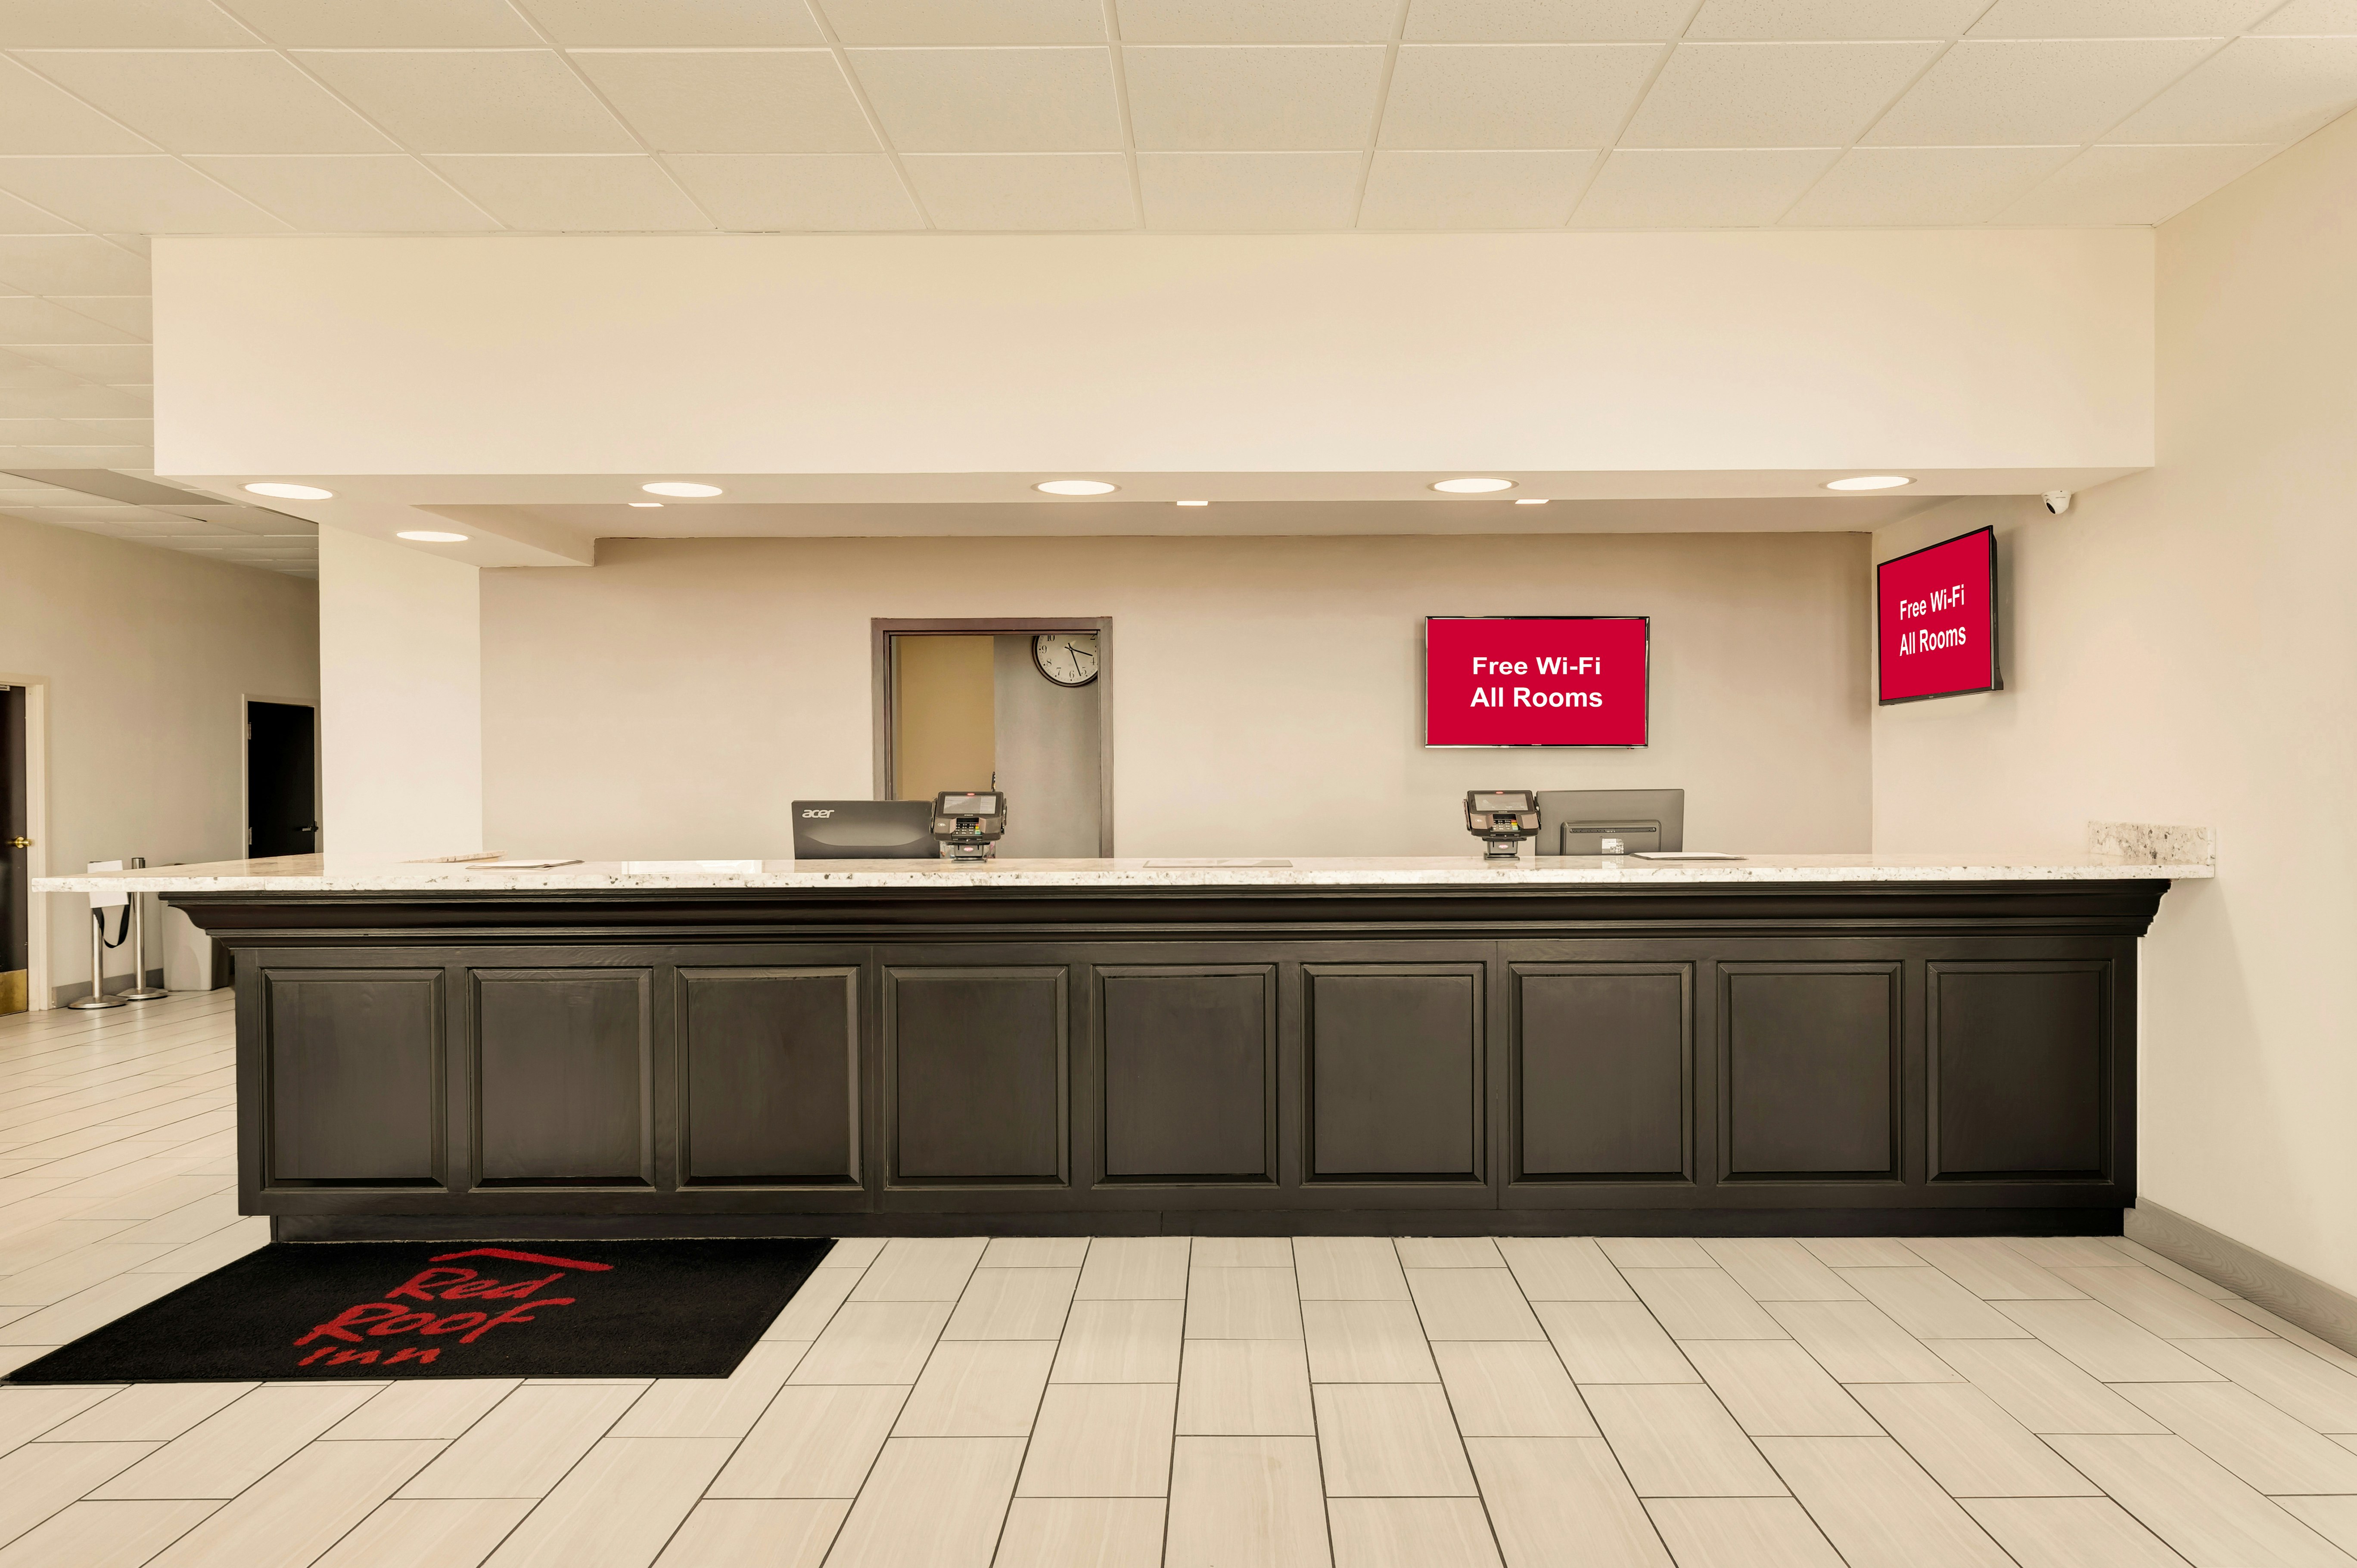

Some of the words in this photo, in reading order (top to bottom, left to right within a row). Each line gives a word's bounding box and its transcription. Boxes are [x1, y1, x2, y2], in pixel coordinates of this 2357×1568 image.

[1900, 599, 1927, 621] Free
[1930, 584, 1964, 613] Wi-Fi
[1899, 631, 1915, 656] All
[1919, 627, 1966, 652] Rooms
[1042, 645, 1047, 654] 9
[1046, 658, 1052, 667] 8
[1090, 657, 1096, 665] 4
[1473, 657, 1528, 675] Free
[1536, 657, 1601, 675] Wi-Fi
[1056, 667, 1061, 676] 7
[1069, 670, 1075, 679] 6
[1081, 667, 1087, 675] 5
[1470, 687, 1503, 707] All
[1514, 687, 1603, 708] Rooms
[802, 809, 835, 818] acer
[386, 1267, 566, 1301] Red
[294, 1298, 575, 1346] Roof
